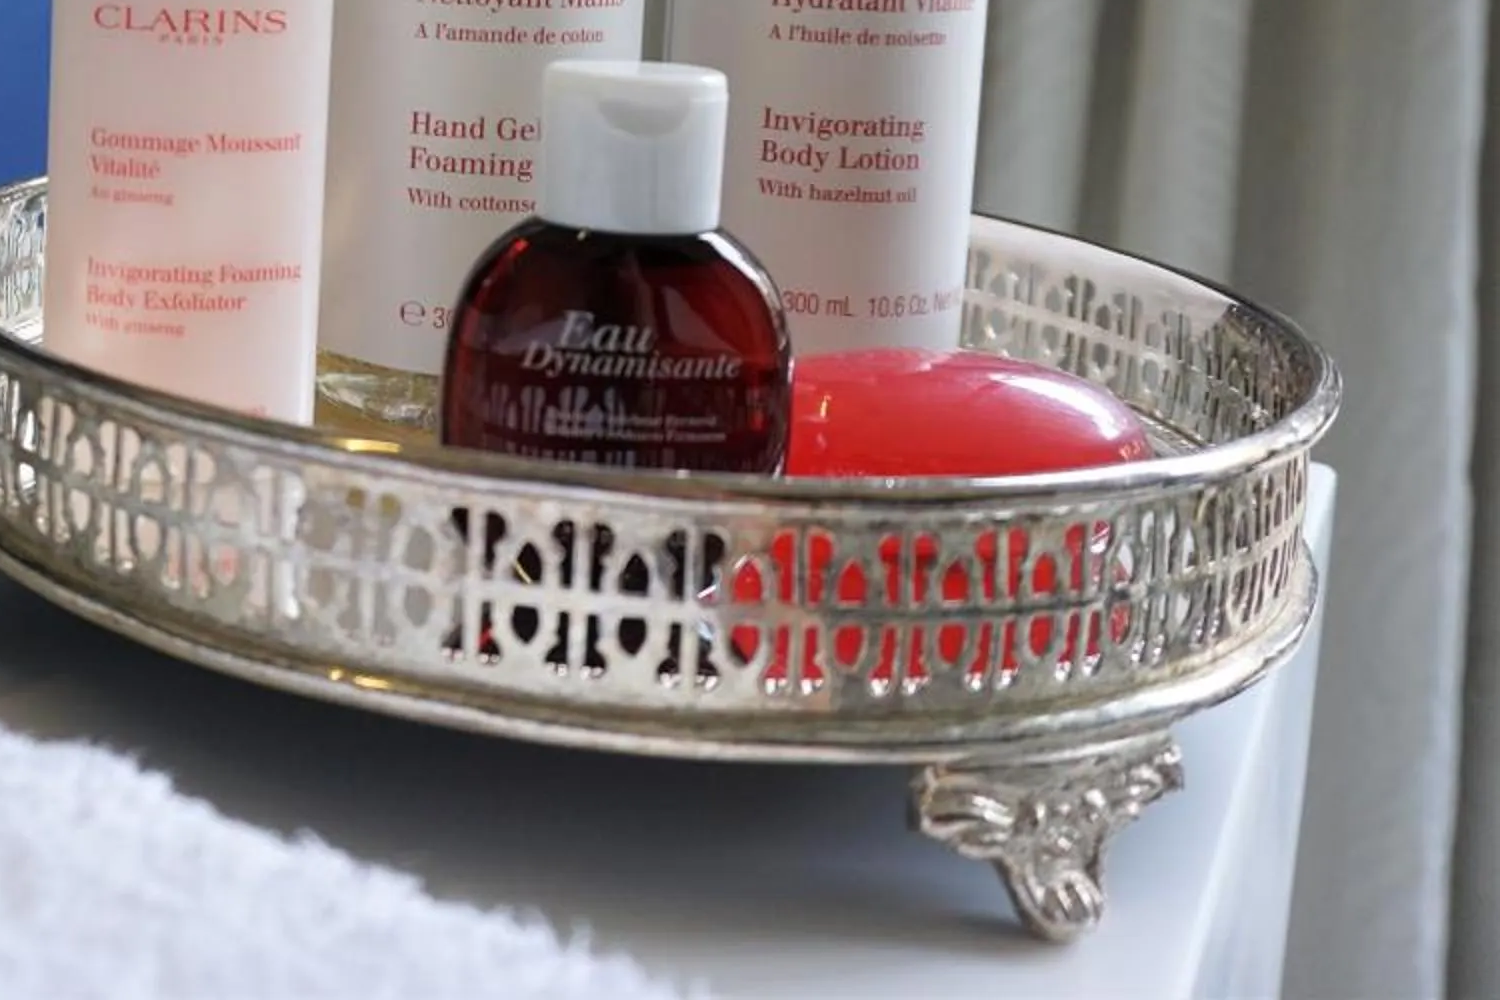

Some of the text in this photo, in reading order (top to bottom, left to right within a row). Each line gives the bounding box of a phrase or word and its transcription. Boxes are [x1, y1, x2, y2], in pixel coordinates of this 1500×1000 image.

[93, 4, 288, 34] CLARINS
[414, 22, 605, 45] A l'amande de coton
[769, 24, 781, 40] A
[788, 25, 851, 46] l'huile
[857, 28, 880, 46] de
[411, 111, 485, 140] Hand
[761, 106, 926, 142] Invigorating
[91, 127, 302, 158] Gommage Moussant
[760, 139, 920, 173] Body Lotion
[409, 146, 533, 183] Foaming
[407, 187, 452, 209] With
[758, 177, 917, 204] With hazelnut oil
[87, 256, 302, 286] Invigorating Foaming
[86, 284, 248, 312] Body Exfoliator
[783, 291, 819, 314] 300
[825, 296, 855, 317] mL
[867, 295, 905, 318] 10.6
[560, 310, 654, 351] Eau
[521, 340, 743, 380] Dynamisante
